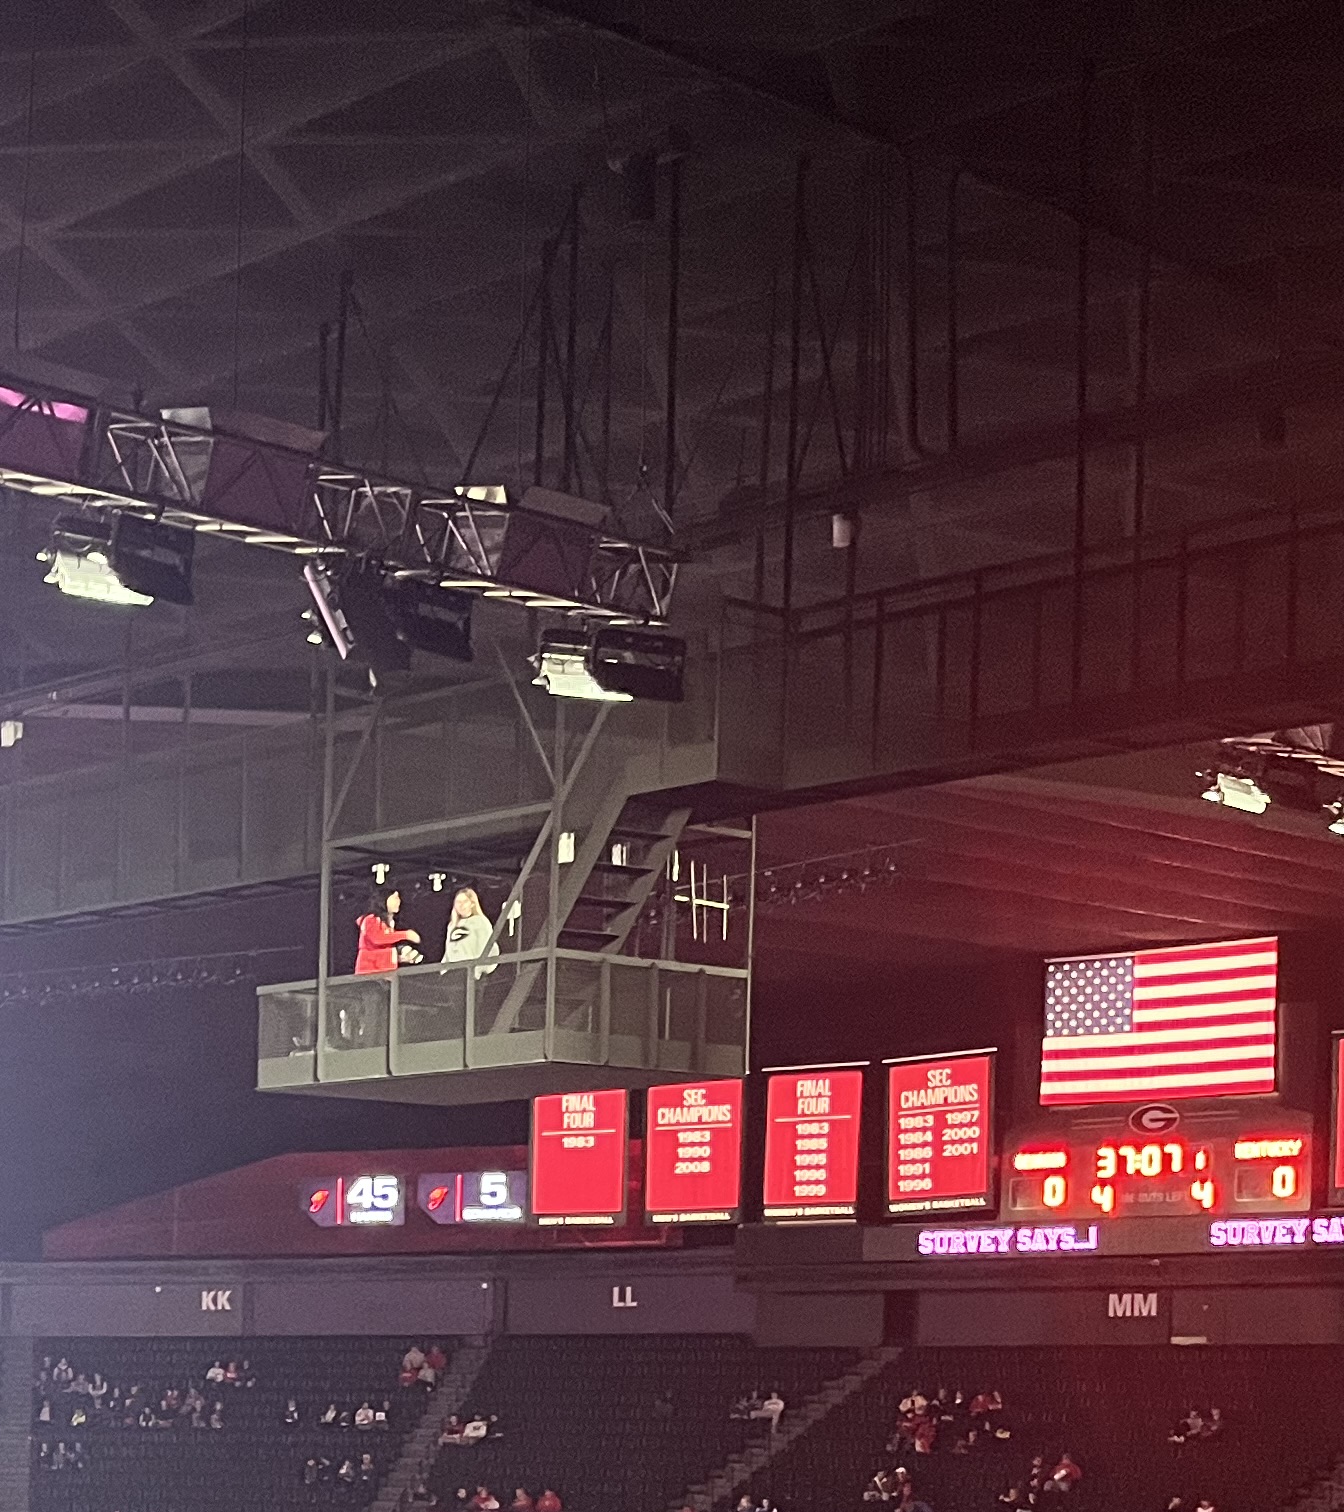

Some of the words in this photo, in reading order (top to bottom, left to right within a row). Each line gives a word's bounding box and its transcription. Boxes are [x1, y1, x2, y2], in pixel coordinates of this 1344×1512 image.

[796, 1078, 832, 1097] FINAL
[927, 1068, 952, 1088] SEC
[562, 1095, 596, 1112] FINAL
[683, 1089, 707, 1106] SEC
[797, 1097, 830, 1115] FOUR
[900, 1084, 979, 1109] CHAMPIONS
[563, 1113, 595, 1129] FOUR
[658, 1104, 731, 1125] CHAMPIONS
[945, 1111, 980, 1125] 1997
[942, 1126, 980, 1141] 2000
[942, 1143, 979, 1157] 2001
[898, 1162, 931, 1176] 1991
[1096, 1143, 1183, 1179] 37:07
[346, 1174, 399, 1209] 45
[480, 1171, 507, 1206] 5
[1043, 1175, 1066, 1207] 0
[1272, 1165, 1296, 1198] 0
[1090, 1185, 1114, 1212] 4
[1190, 1181, 1214, 1208] 4
[917, 1229, 1013, 1255] SURVEY
[1210, 1217, 1310, 1247] SURVEY
[201, 1290, 232, 1311] KK
[612, 1286, 637, 1307] LL
[1108, 1292, 1158, 1317] MM
